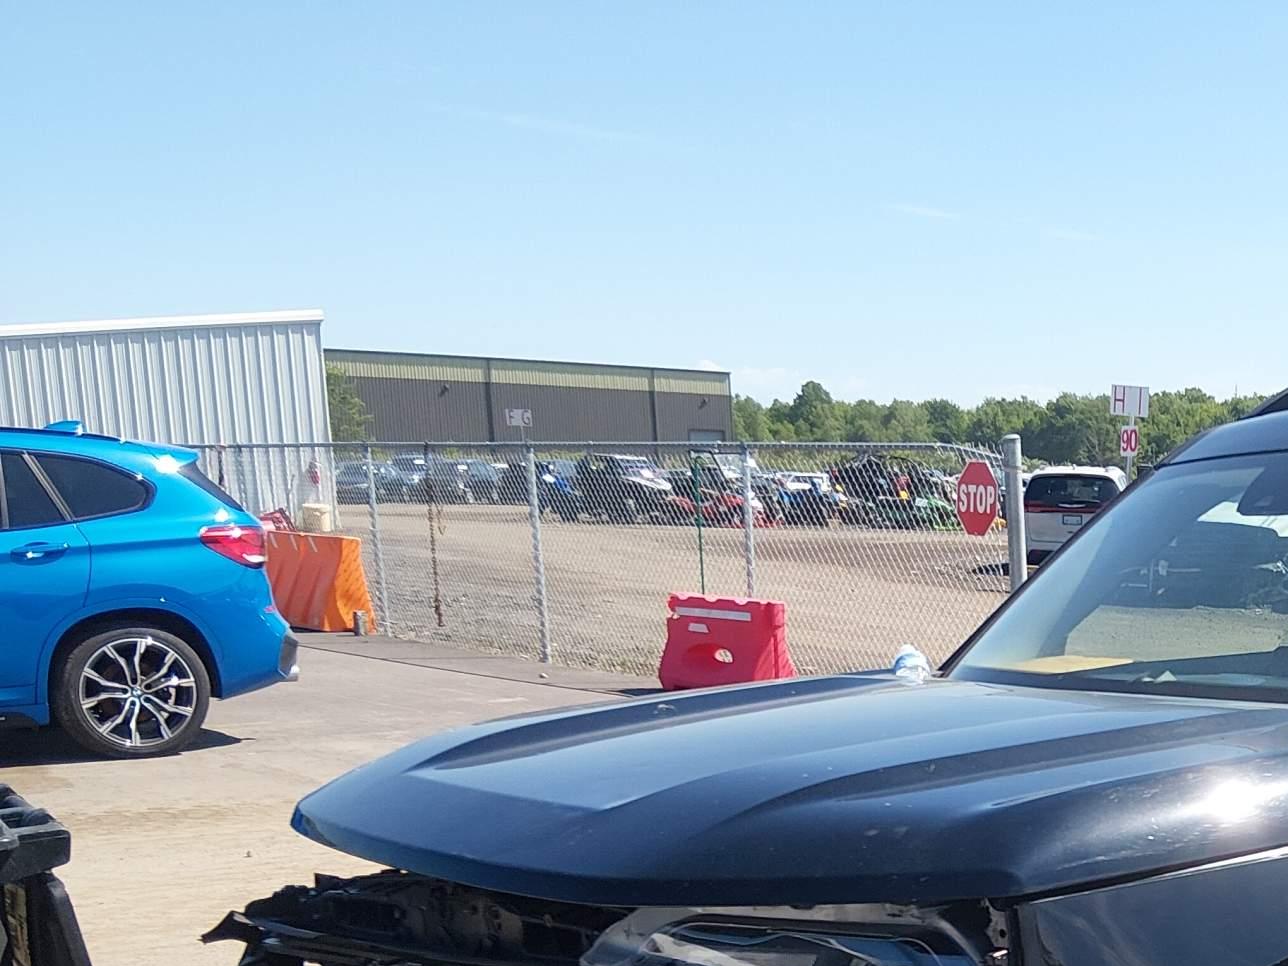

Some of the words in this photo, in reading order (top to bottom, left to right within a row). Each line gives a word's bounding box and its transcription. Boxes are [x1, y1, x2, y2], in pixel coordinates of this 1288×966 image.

[1113, 385, 1126, 413] H
[1121, 429, 1138, 452] 90
[958, 484, 996, 514] STOP
